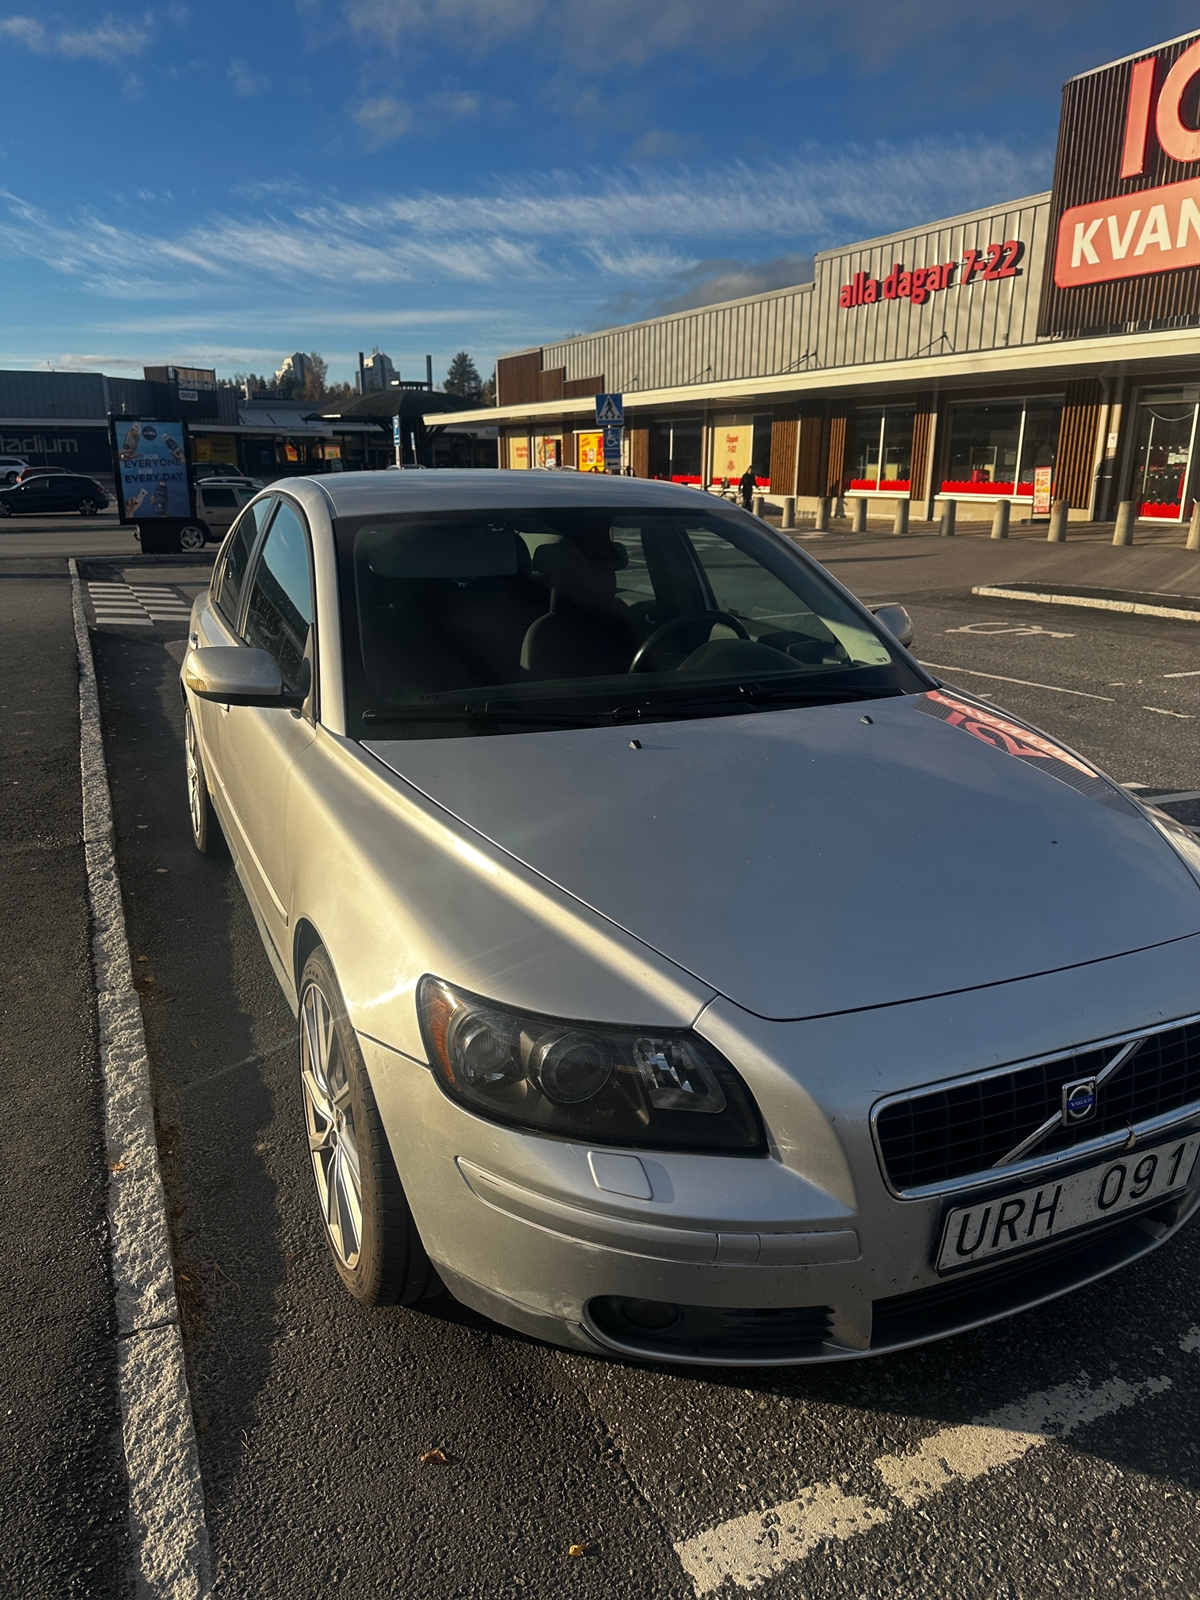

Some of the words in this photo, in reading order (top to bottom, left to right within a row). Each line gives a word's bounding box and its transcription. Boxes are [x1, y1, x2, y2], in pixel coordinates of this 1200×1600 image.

[839, 271, 877, 308] alla
[883, 261, 956, 305] dagar
[960, 239, 1020, 285] 7-22
[124, 457, 182, 469] EVERYONE
[125, 473, 160, 484] EVERY
[162, 472, 183, 482] DAY
[1070, 1096, 1093, 1107] VOLVO
[955, 1183, 1063, 1256] URH
[1097, 1142, 1187, 1211] 091
